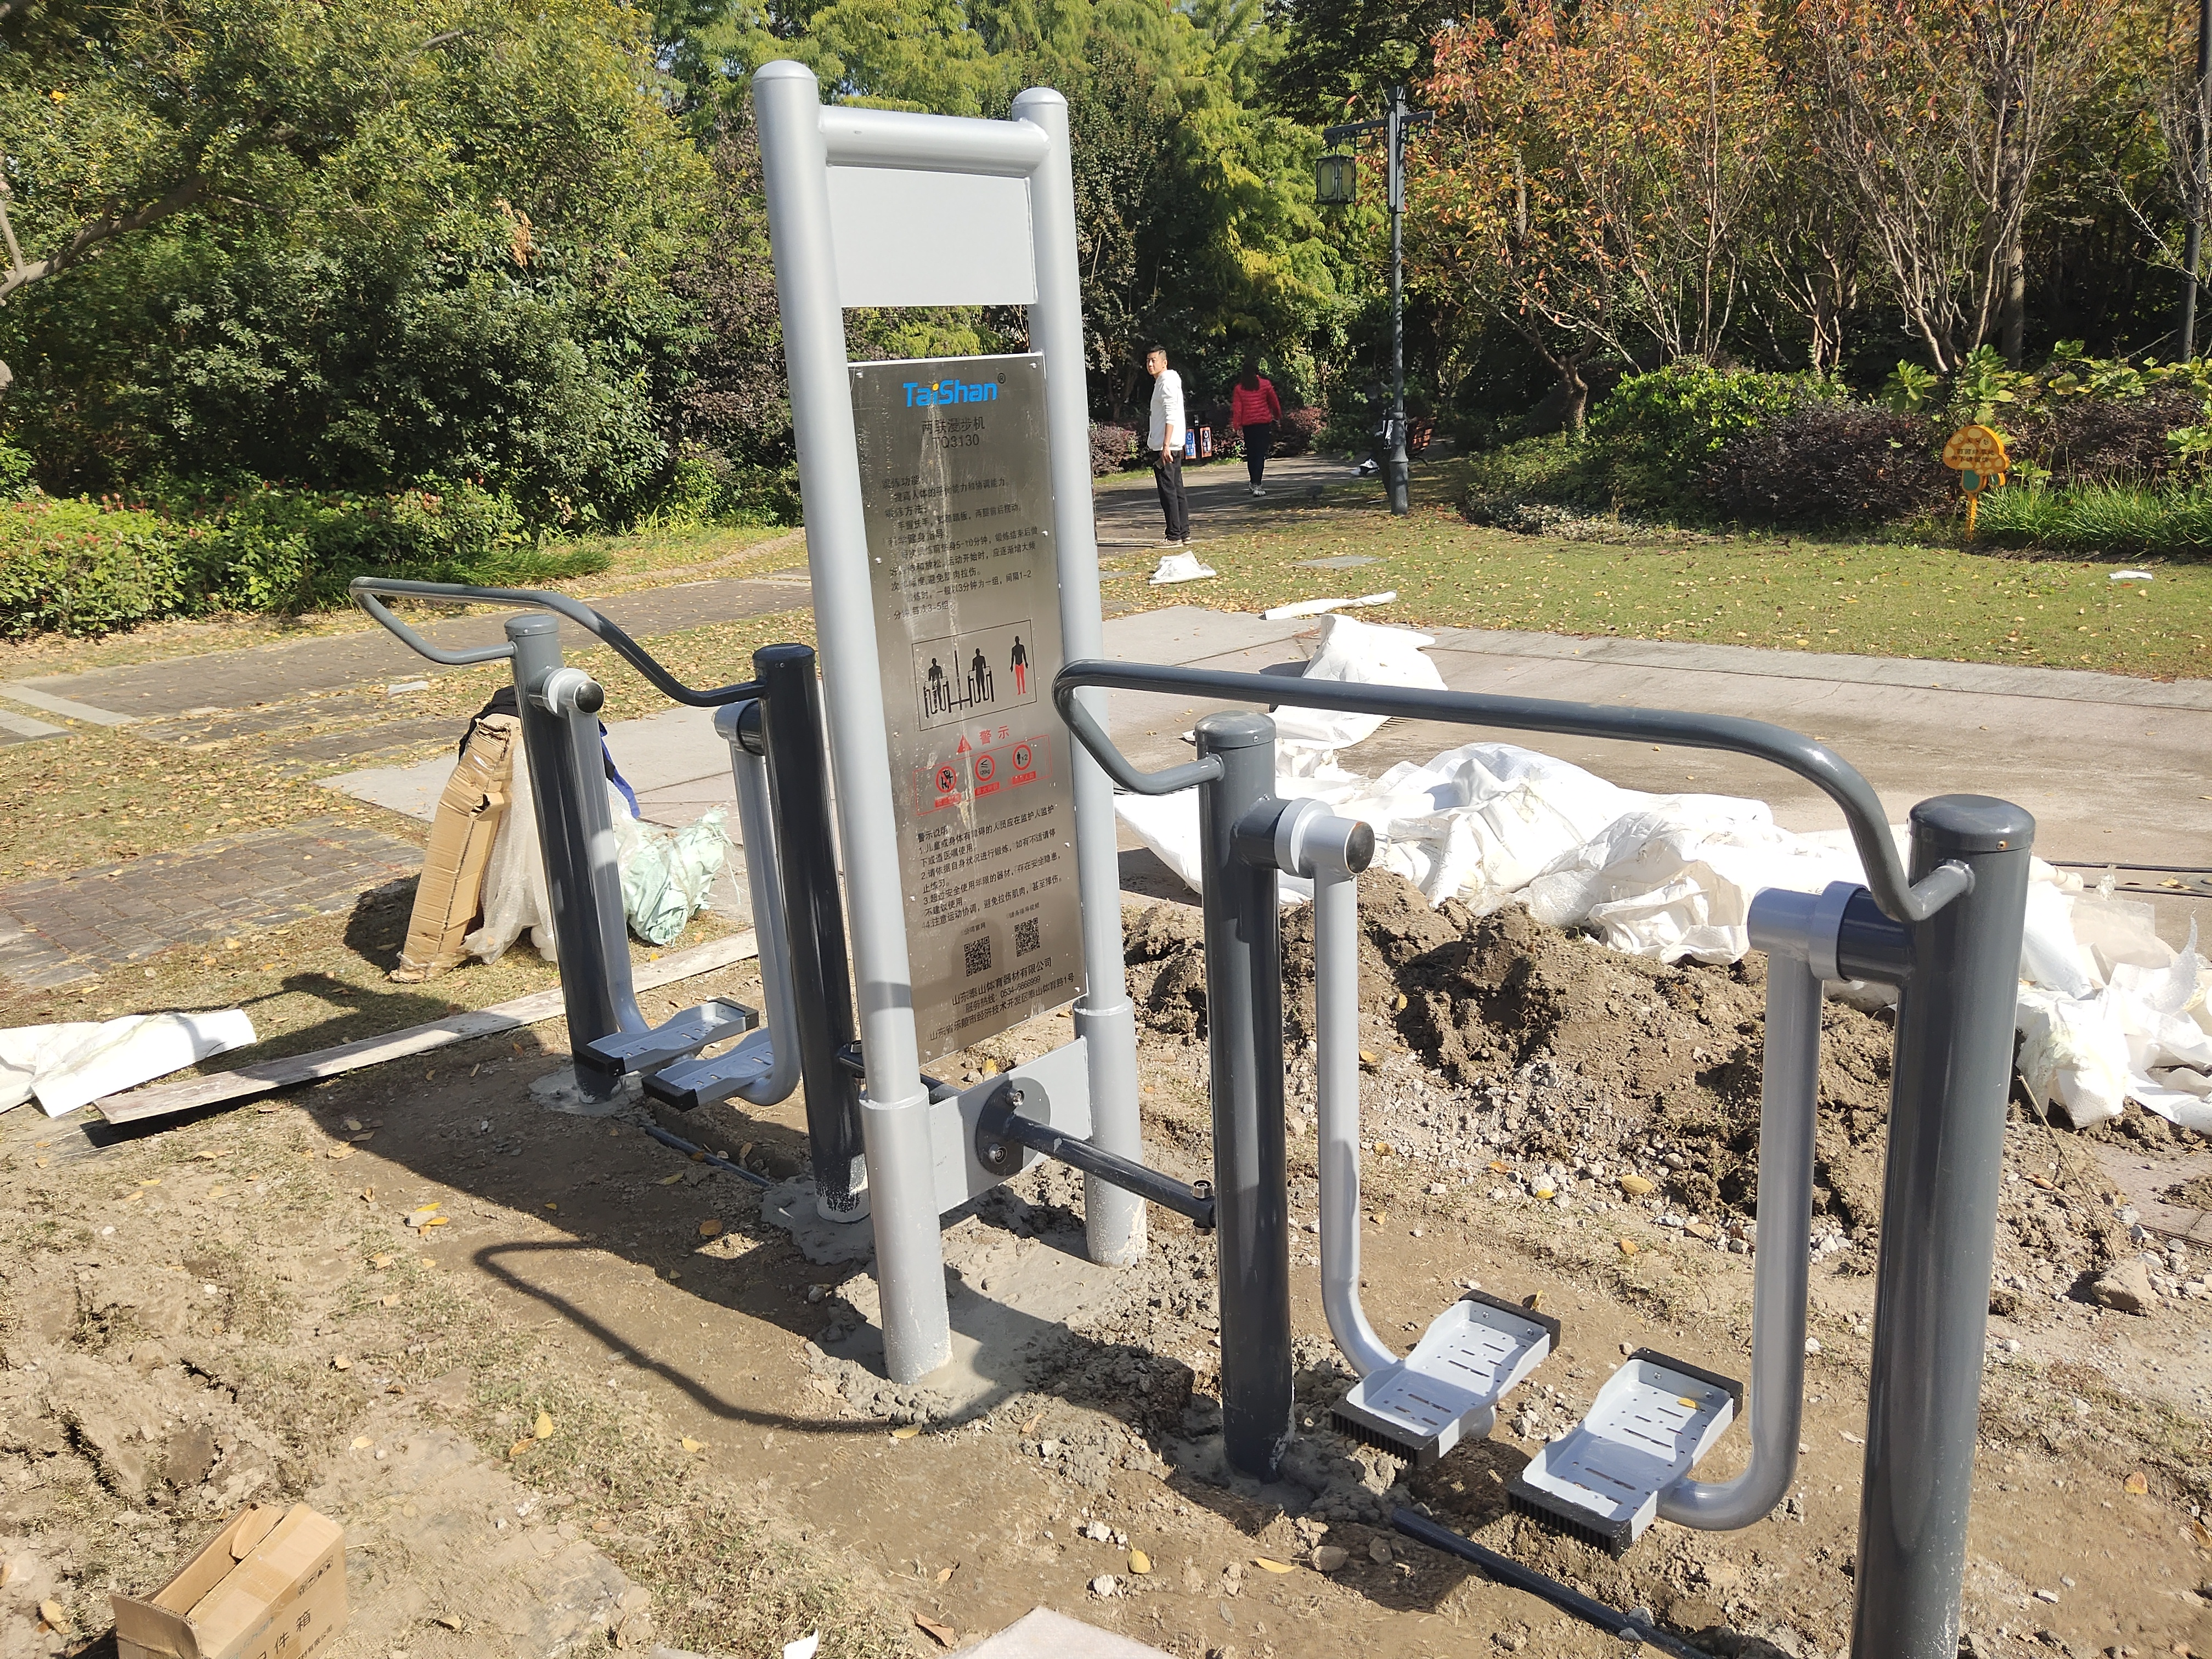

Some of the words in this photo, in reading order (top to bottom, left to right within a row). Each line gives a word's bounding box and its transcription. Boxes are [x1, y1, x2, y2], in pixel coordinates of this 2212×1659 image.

[904, 379, 998, 407] TaiShan
[921, 416, 986, 434] 两联漫步机
[979, 725, 1009, 745] 警示
[923, 878, 950, 894] 止练习。
[952, 957, 1052, 1006] 山东泰山体育器材有限公司
[256, 1608, 311, 1659] 件箱
